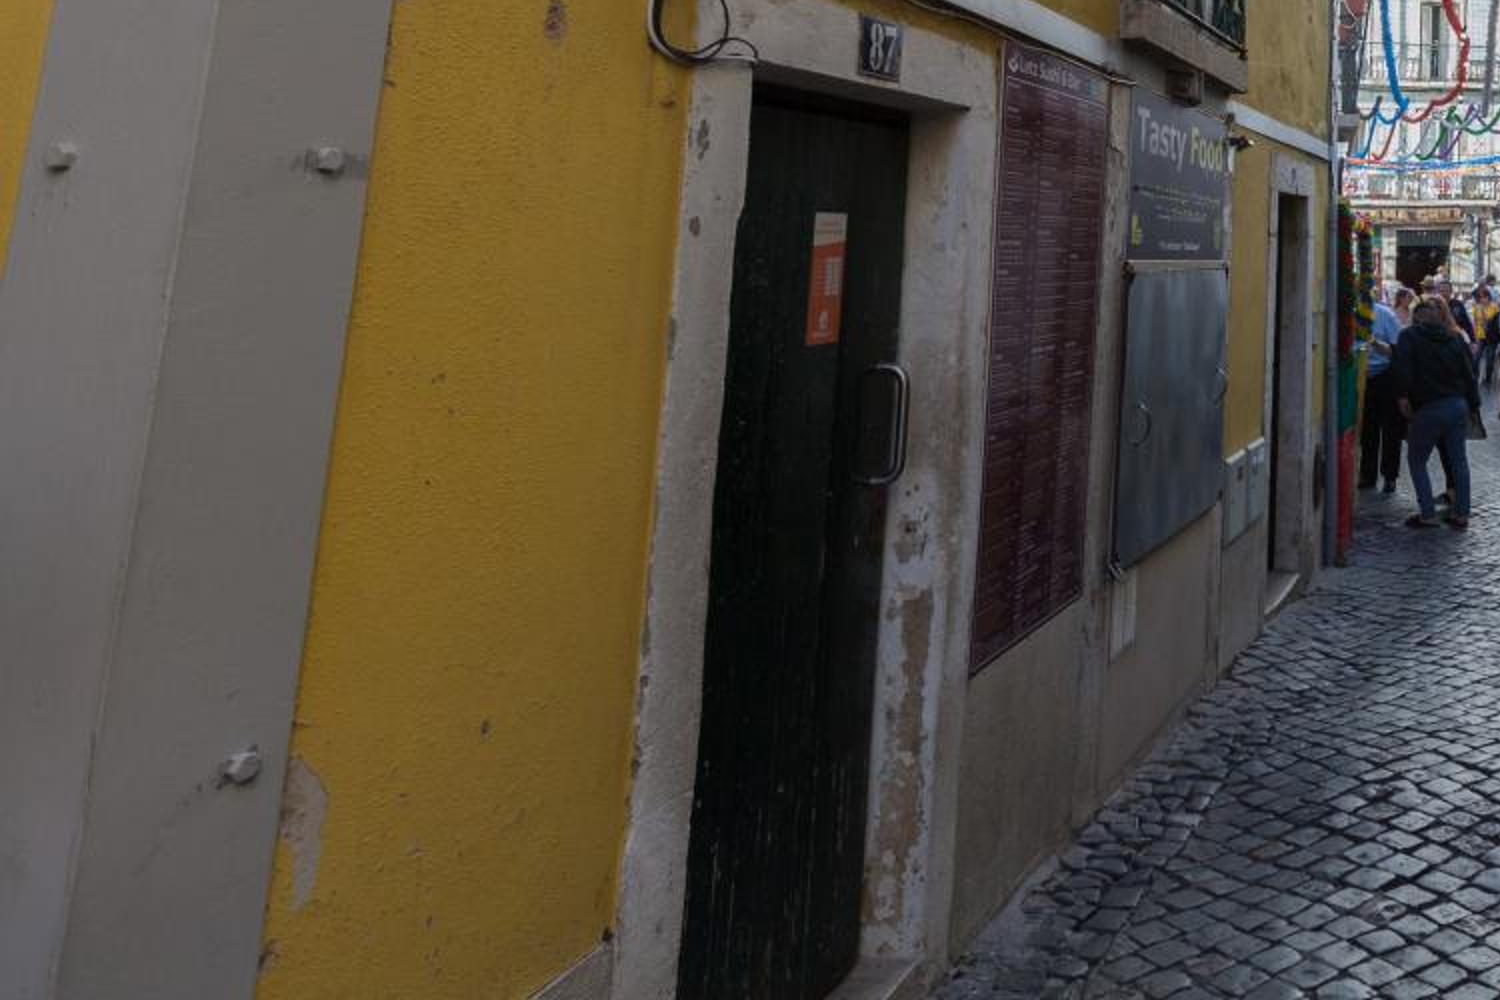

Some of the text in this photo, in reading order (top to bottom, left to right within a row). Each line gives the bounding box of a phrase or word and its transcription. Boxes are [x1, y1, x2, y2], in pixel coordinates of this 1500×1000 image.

[868, 22, 898, 74] 87
[1136, 104, 1224, 174] Tasty Food
